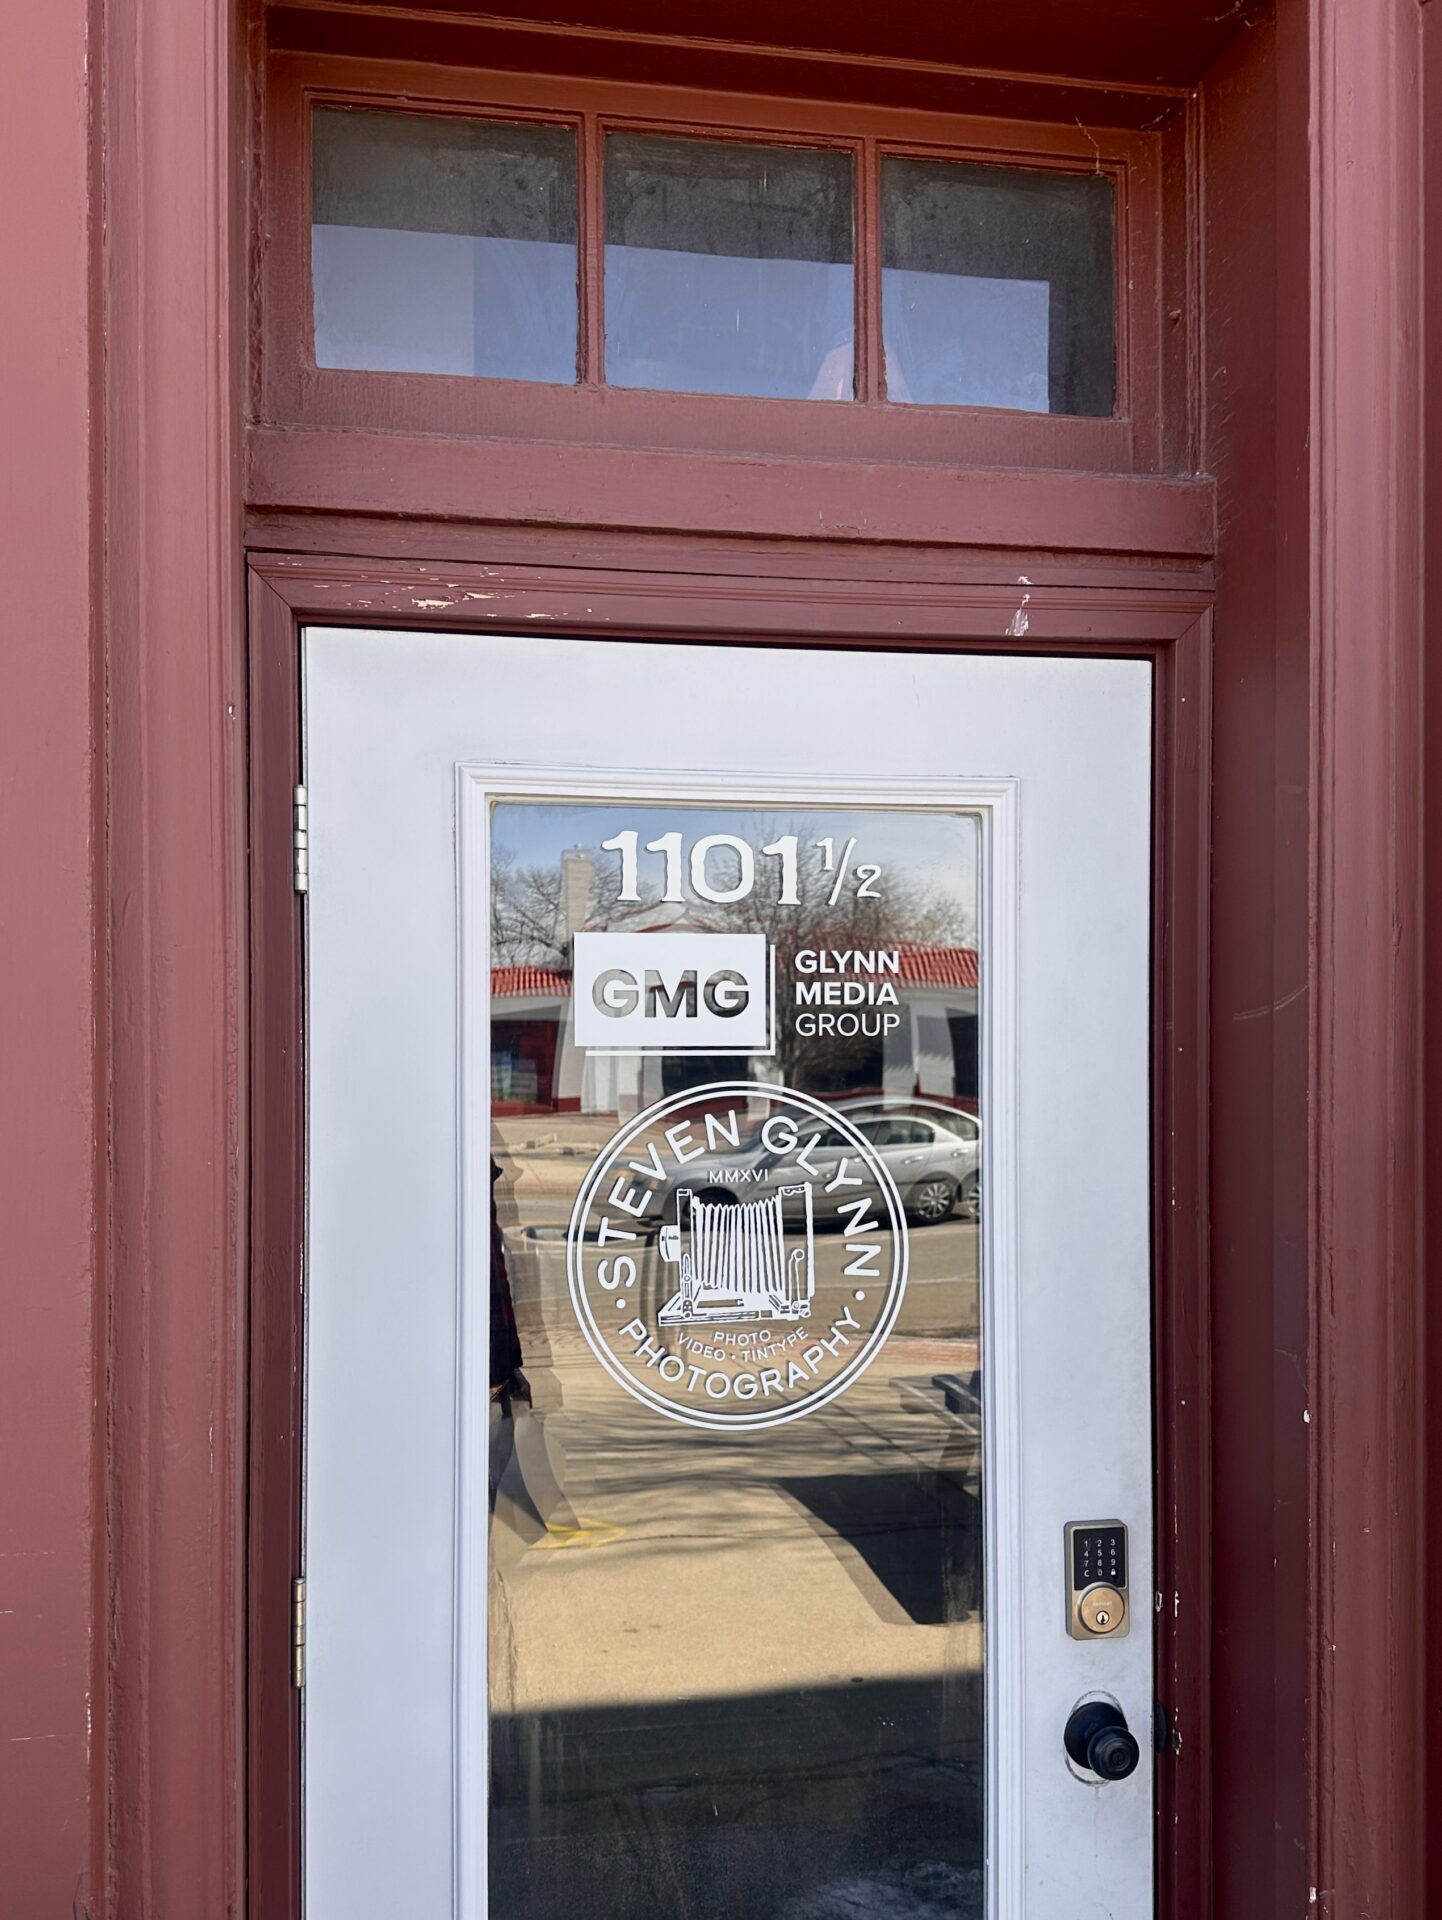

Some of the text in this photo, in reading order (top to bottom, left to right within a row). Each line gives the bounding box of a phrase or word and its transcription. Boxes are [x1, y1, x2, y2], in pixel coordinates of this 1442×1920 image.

[795, 950, 900, 974] GLYNN
[592, 968, 750, 1018] GMG
[795, 982, 899, 1005] MEDIA
[795, 1013, 901, 1037] GROUP
[709, 1169, 769, 1184] MMXVI
[597, 1109, 882, 1291] STEVEN GLYNN
[678, 1326, 809, 1363] VIDEO TINTYPE
[713, 1329, 771, 1346] PHOTO
[618, 1306, 861, 1400] PHOTOGRAPHY
[1097, 1539, 1102, 1547] 2
[1110, 1538, 1116, 1546] 3
[1097, 1549, 1102, 1557] 5
[1110, 1548, 1116, 1556] 6
[1097, 1559, 1102, 1567] 8
[1110, 1558, 1116, 1566] 9
[1097, 1569, 1103, 1577] 0
